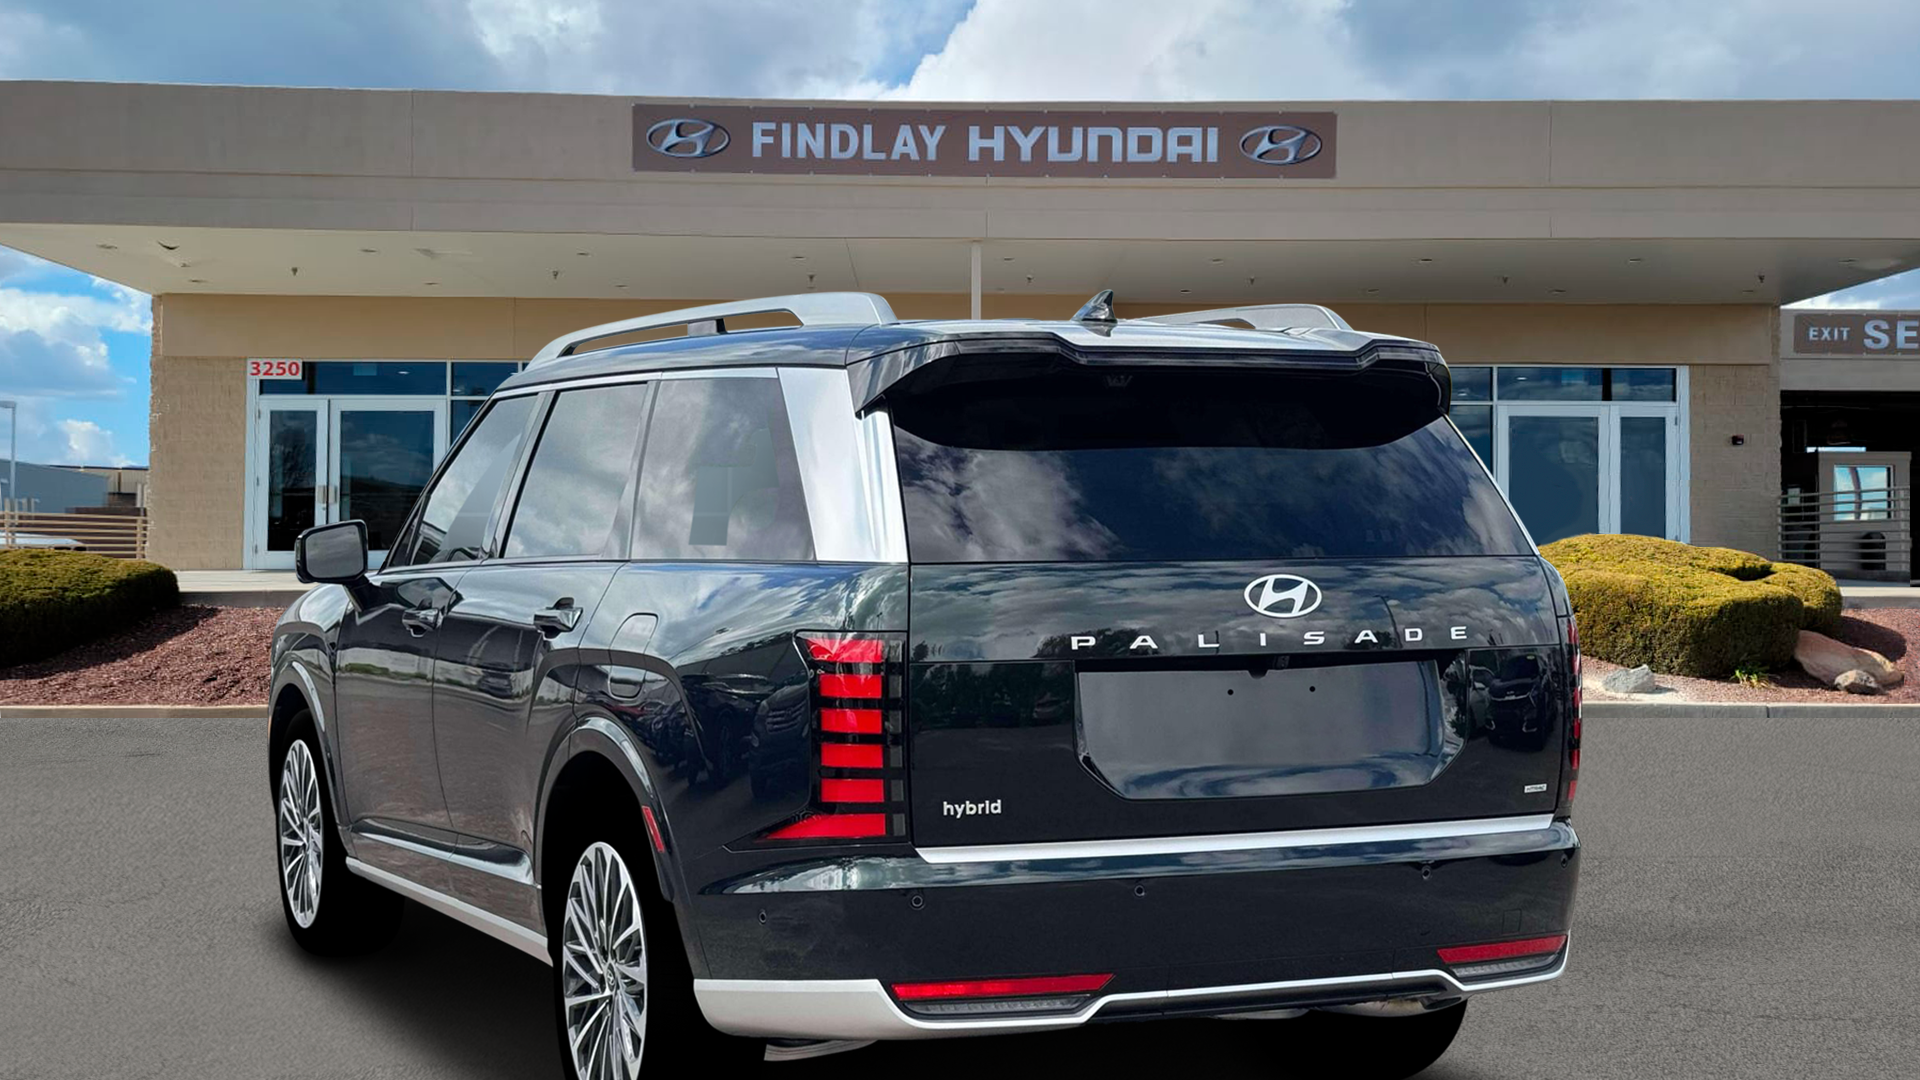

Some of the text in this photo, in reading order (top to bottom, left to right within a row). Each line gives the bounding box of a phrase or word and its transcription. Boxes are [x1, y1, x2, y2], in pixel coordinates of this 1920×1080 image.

[752, 122, 1219, 163] FINDLAY HYUNDAI
[1809, 319, 1920, 349] EXIT SE
[249, 361, 300, 376] 3250
[1070, 625, 1468, 650] PALISADE
[943, 799, 1002, 819] hybrid
